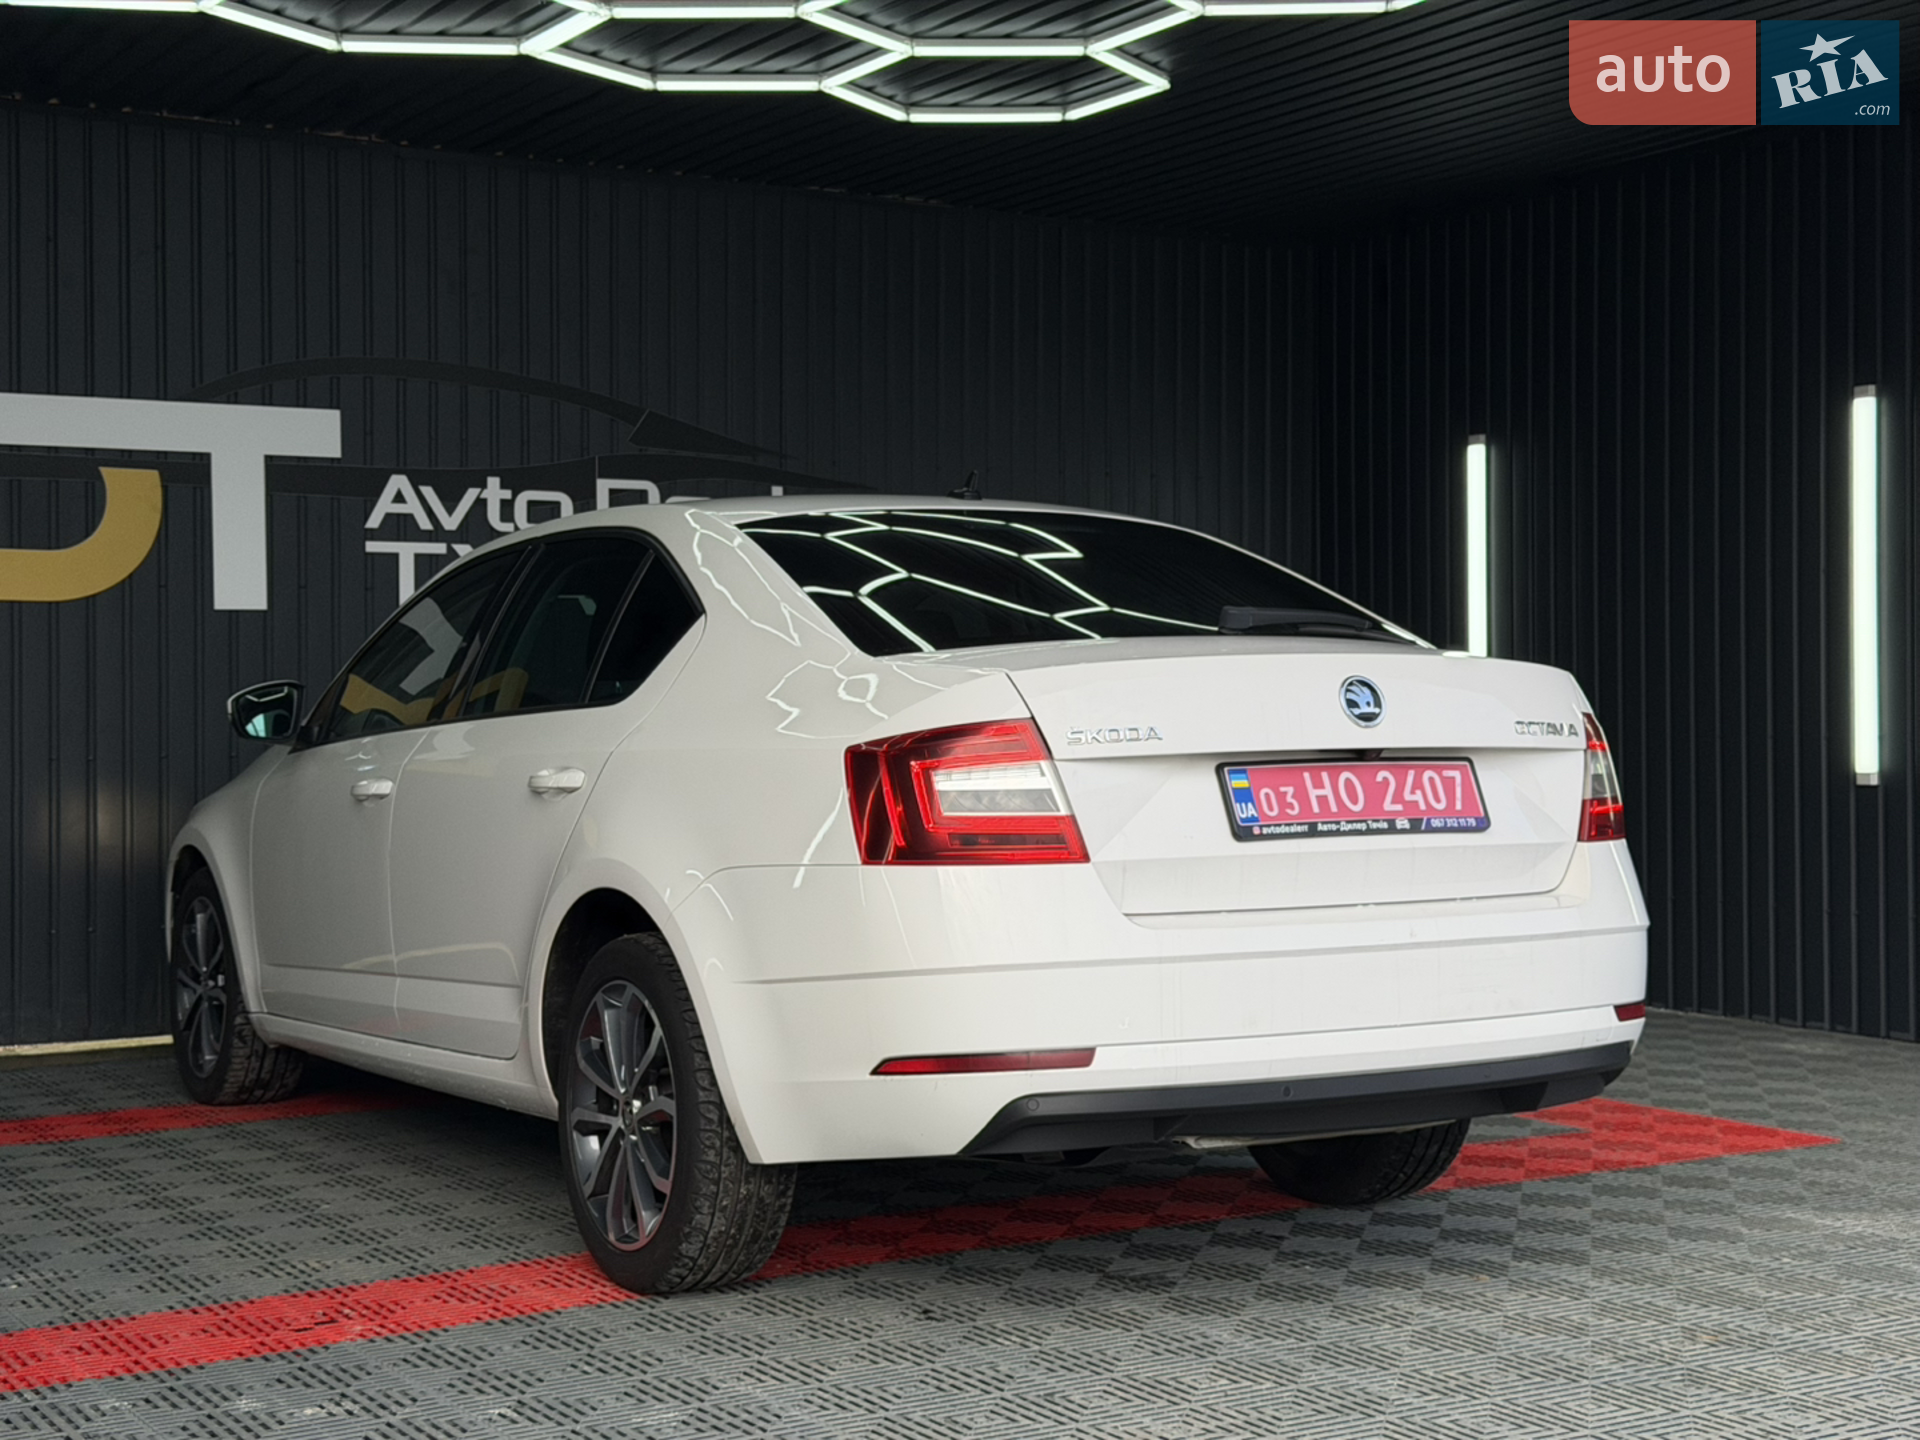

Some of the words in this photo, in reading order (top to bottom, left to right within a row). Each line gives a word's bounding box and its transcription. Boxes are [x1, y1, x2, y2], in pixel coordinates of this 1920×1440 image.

[364, 473, 574, 533] Avto
[1514, 720, 1579, 737] OCTAVIA
[1259, 786, 1300, 817] 03
[1375, 770, 1462, 812] 2407
[1236, 802, 1258, 819] UA
